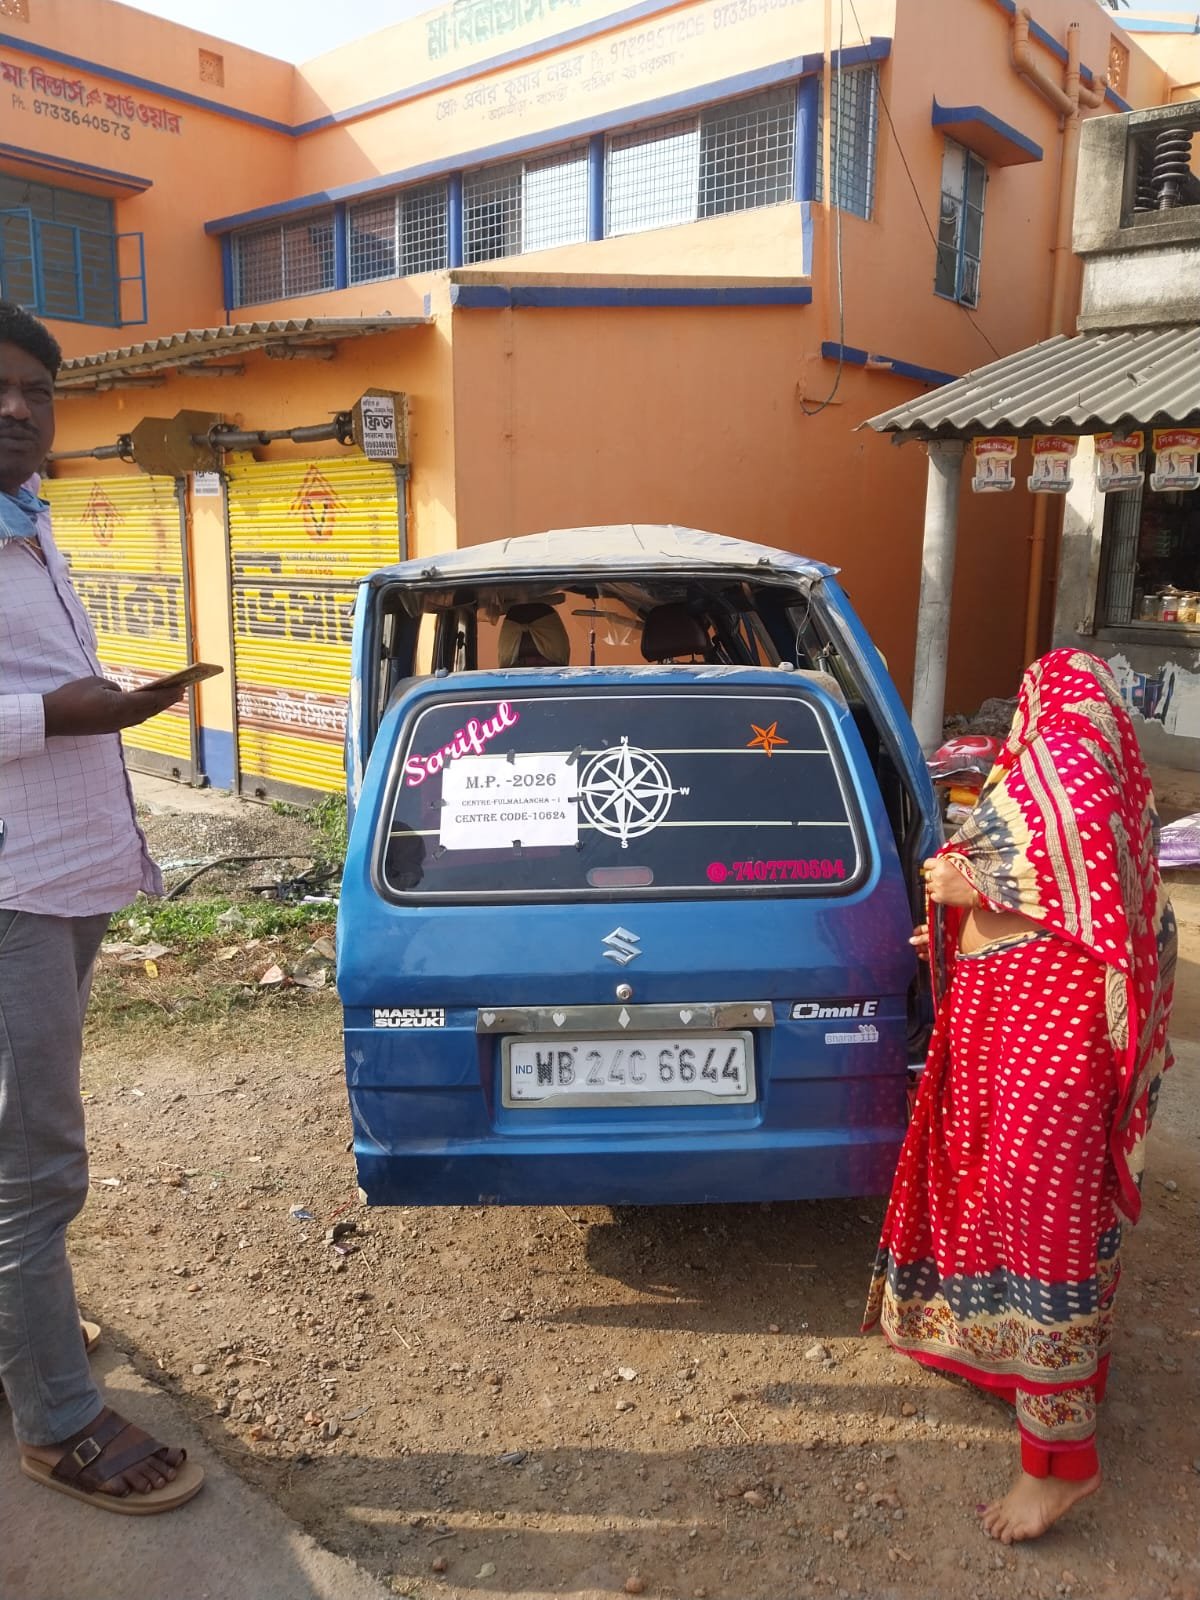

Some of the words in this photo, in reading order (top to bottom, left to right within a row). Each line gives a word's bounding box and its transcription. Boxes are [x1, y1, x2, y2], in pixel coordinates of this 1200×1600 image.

[0, 61, 23, 88] মা
[363, 408, 393, 430] ফ্রিজ
[406, 702, 520, 786] Sariful
[465, 775, 501, 790] M.P.
[679, 787, 690, 795] W
[455, 813, 497, 824] CENTRE
[499, 811, 566, 822] CODE-10624
[621, 841, 628, 849] S
[374, 1008, 445, 1018] MARUTI
[792, 1003, 860, 1019] Omni
[862, 1001, 878, 1017] E
[374, 1018, 445, 1028] SUZUKI
[515, 1064, 533, 1075] IND
[535, 1051, 577, 1087] WB
[585, 1049, 647, 1086] 24C
[658, 1046, 740, 1084] 6644
